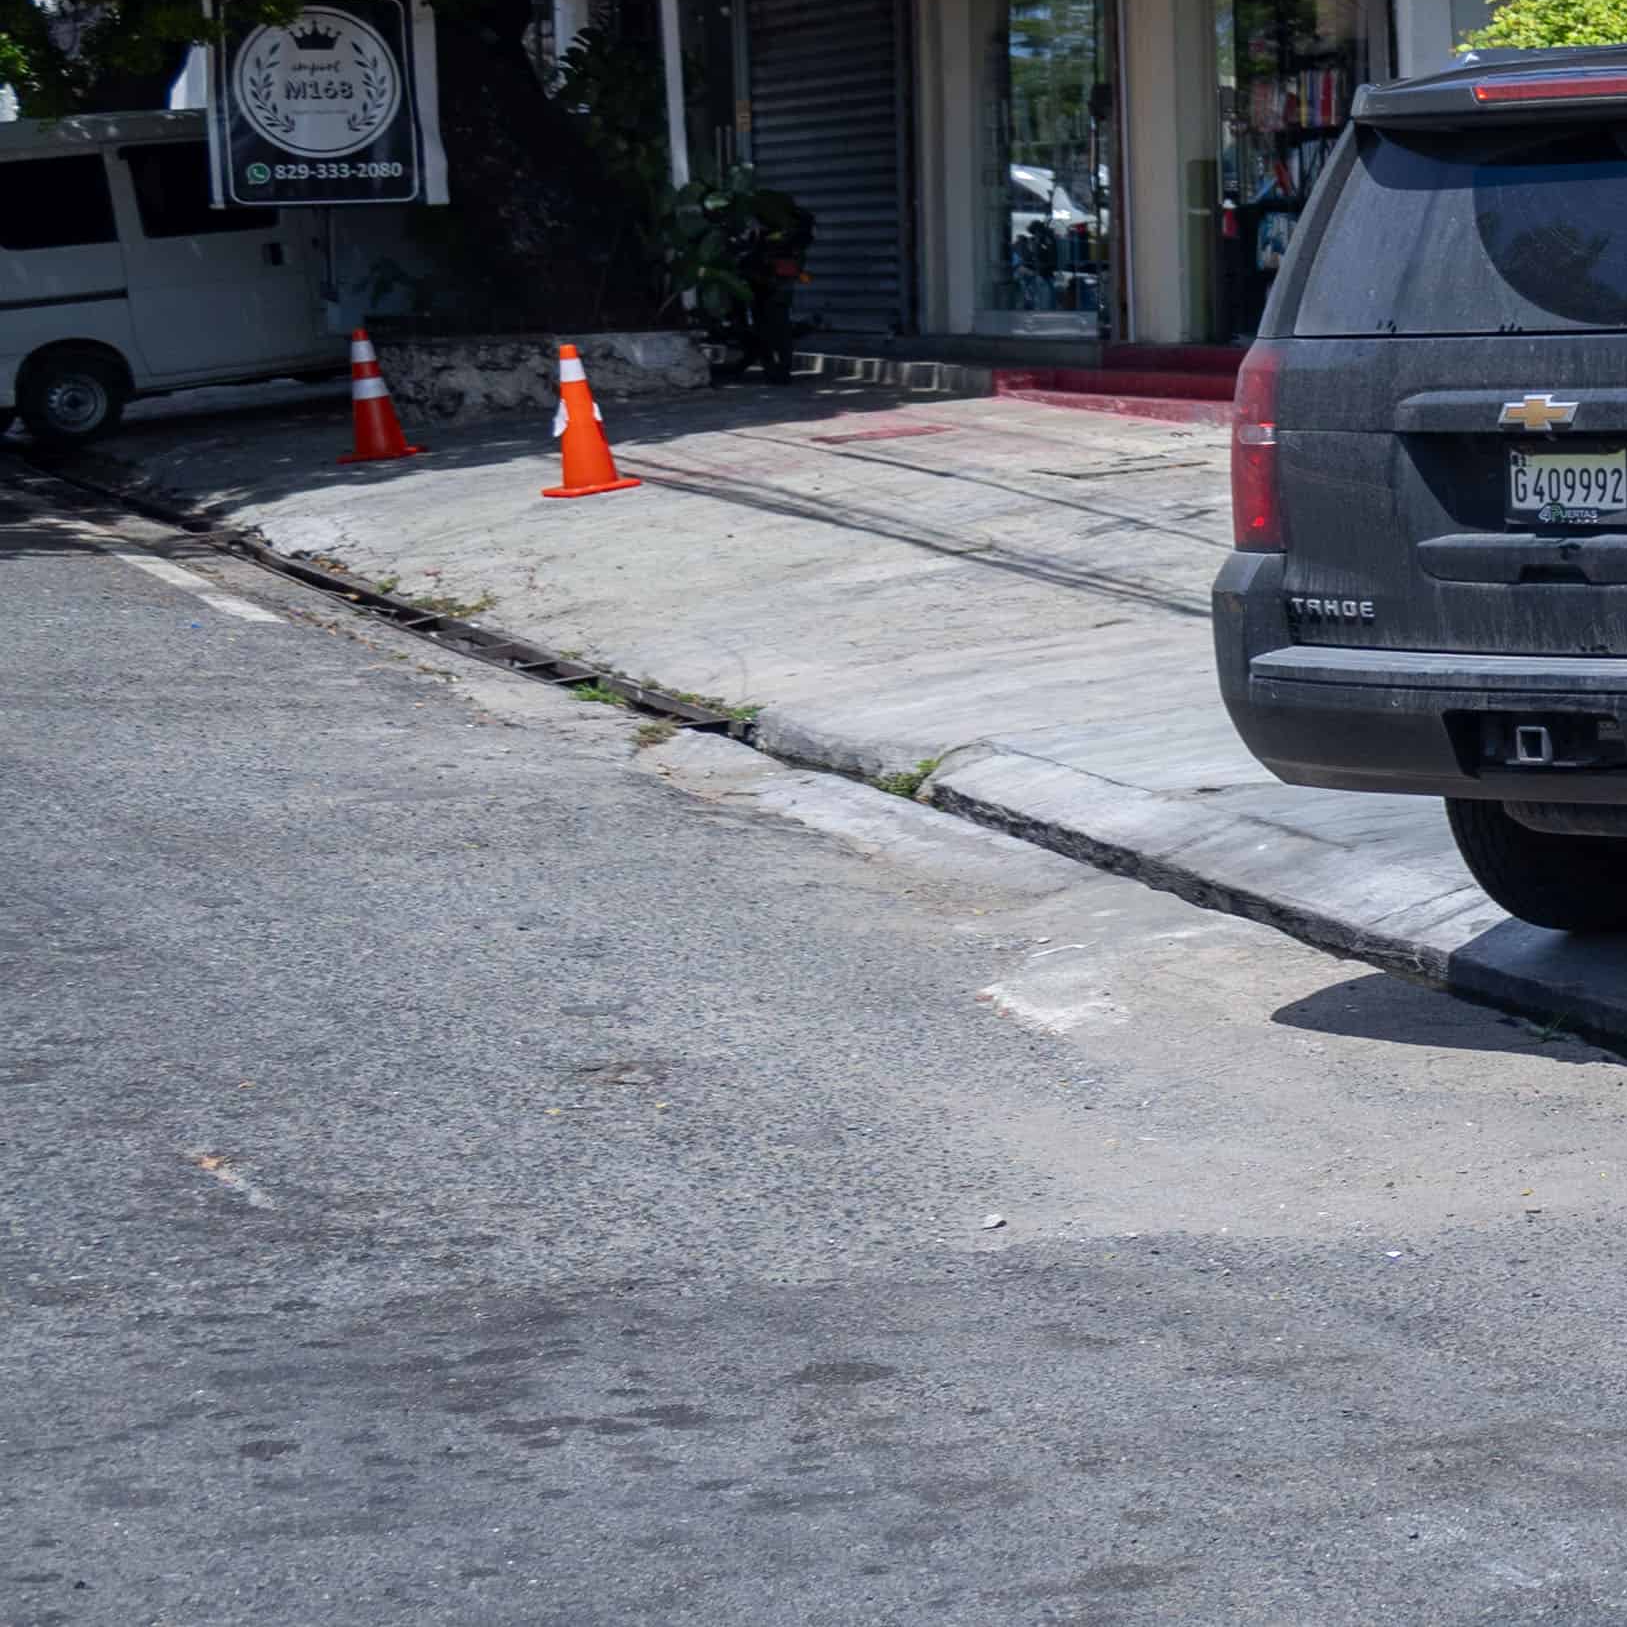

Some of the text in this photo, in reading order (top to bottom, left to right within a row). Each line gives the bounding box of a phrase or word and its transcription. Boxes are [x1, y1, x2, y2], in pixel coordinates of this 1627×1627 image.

[285, 80, 353, 101] M168
[275, 162, 403, 180] 829-333-2080
[1515, 467, 1624, 504] G409992
[1291, 597, 1376, 618] TAHOE
